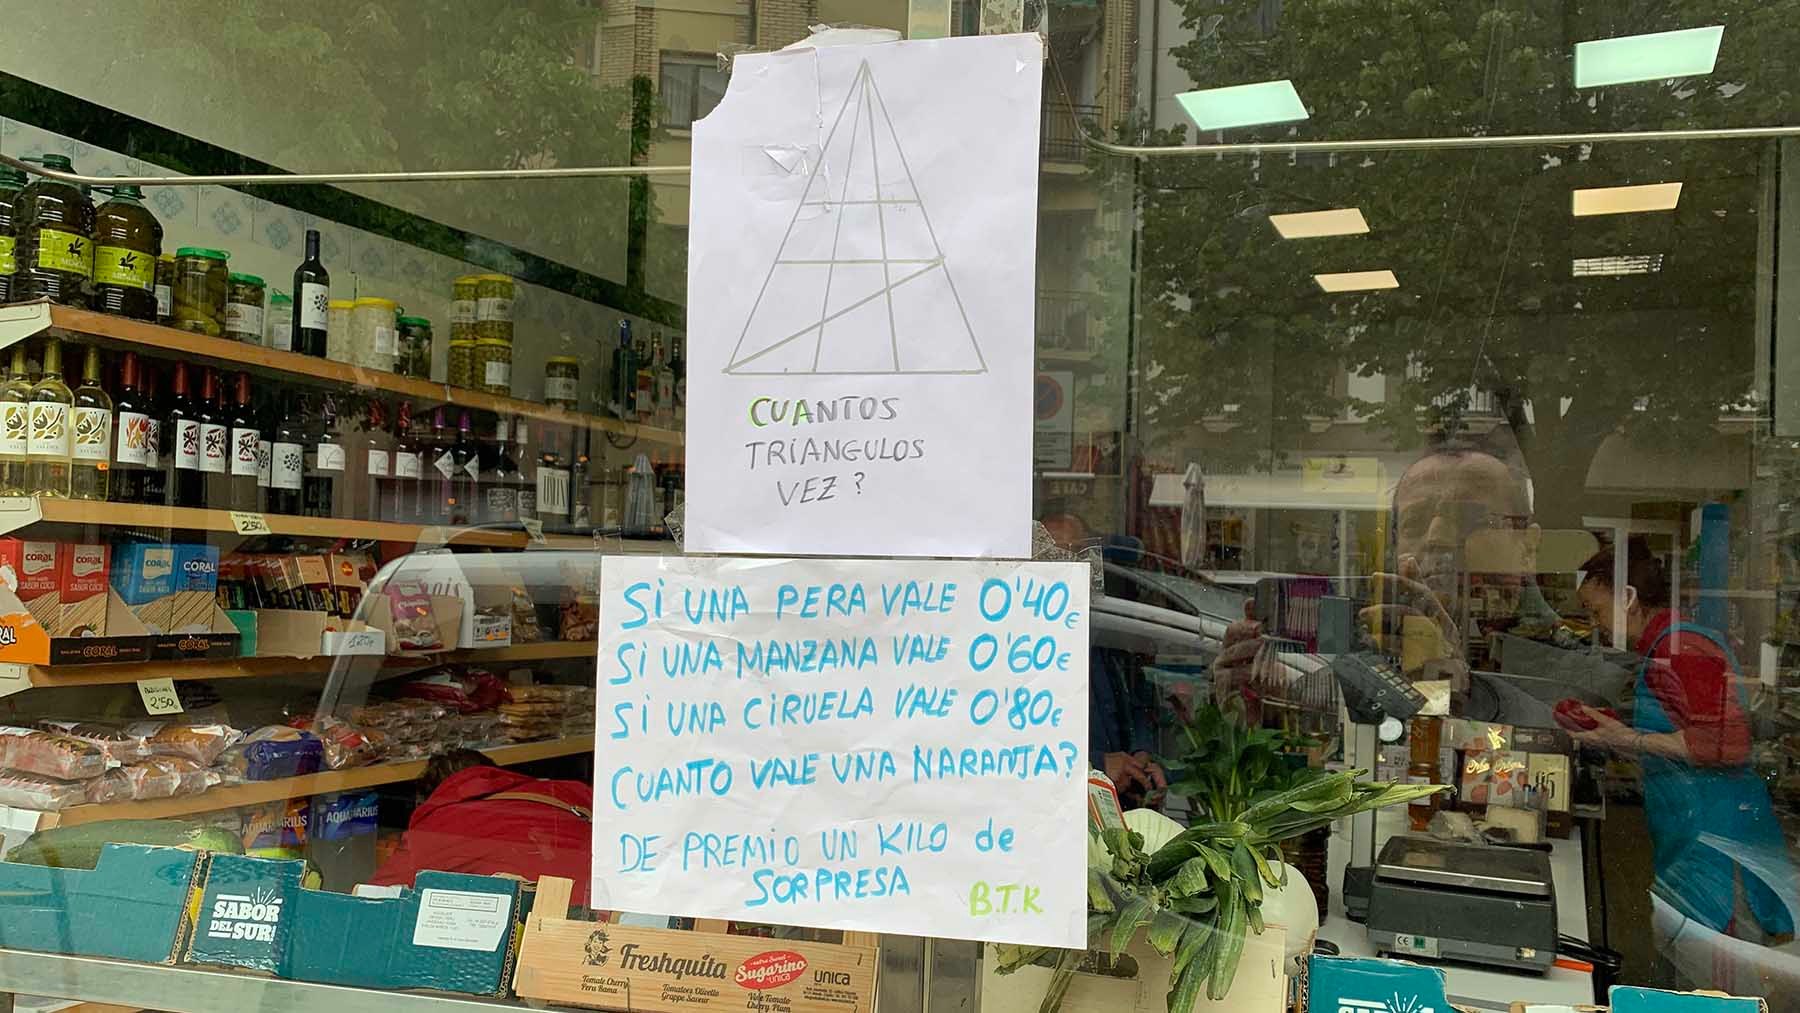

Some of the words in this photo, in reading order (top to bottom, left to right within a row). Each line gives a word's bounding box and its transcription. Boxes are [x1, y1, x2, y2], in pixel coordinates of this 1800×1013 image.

[748, 396, 899, 426] CUANTOS
[777, 476, 837, 506] VEZ
[184, 561, 215, 572] CORAL
[685, 586, 749, 625] UNA
[776, 583, 867, 619] PERA
[881, 580, 958, 615] VALE
[662, 641, 724, 679] UNA
[736, 639, 878, 678] MANZANA
[894, 633, 951, 666] VALE
[668, 703, 726, 737] UNA
[895, 686, 957, 719] VALE
[611, 758, 733, 810] CUANTO
[751, 753, 820, 790] VALE
[831, 752, 896, 784] UNA
[913, 741, 1078, 782] NARANJA?
[620, 834, 661, 873] DE
[822, 830, 857, 860] UN
[877, 822, 948, 854] KILO
[976, 819, 1014, 853] de
[746, 868, 910, 907] SORPRESA
[213, 901, 280, 922] SABOR
[210, 920, 233, 931] DEL
[232, 922, 277, 944] SUR!
[620, 944, 727, 979] Freshquita
[735, 960, 808, 983] Sugarino
